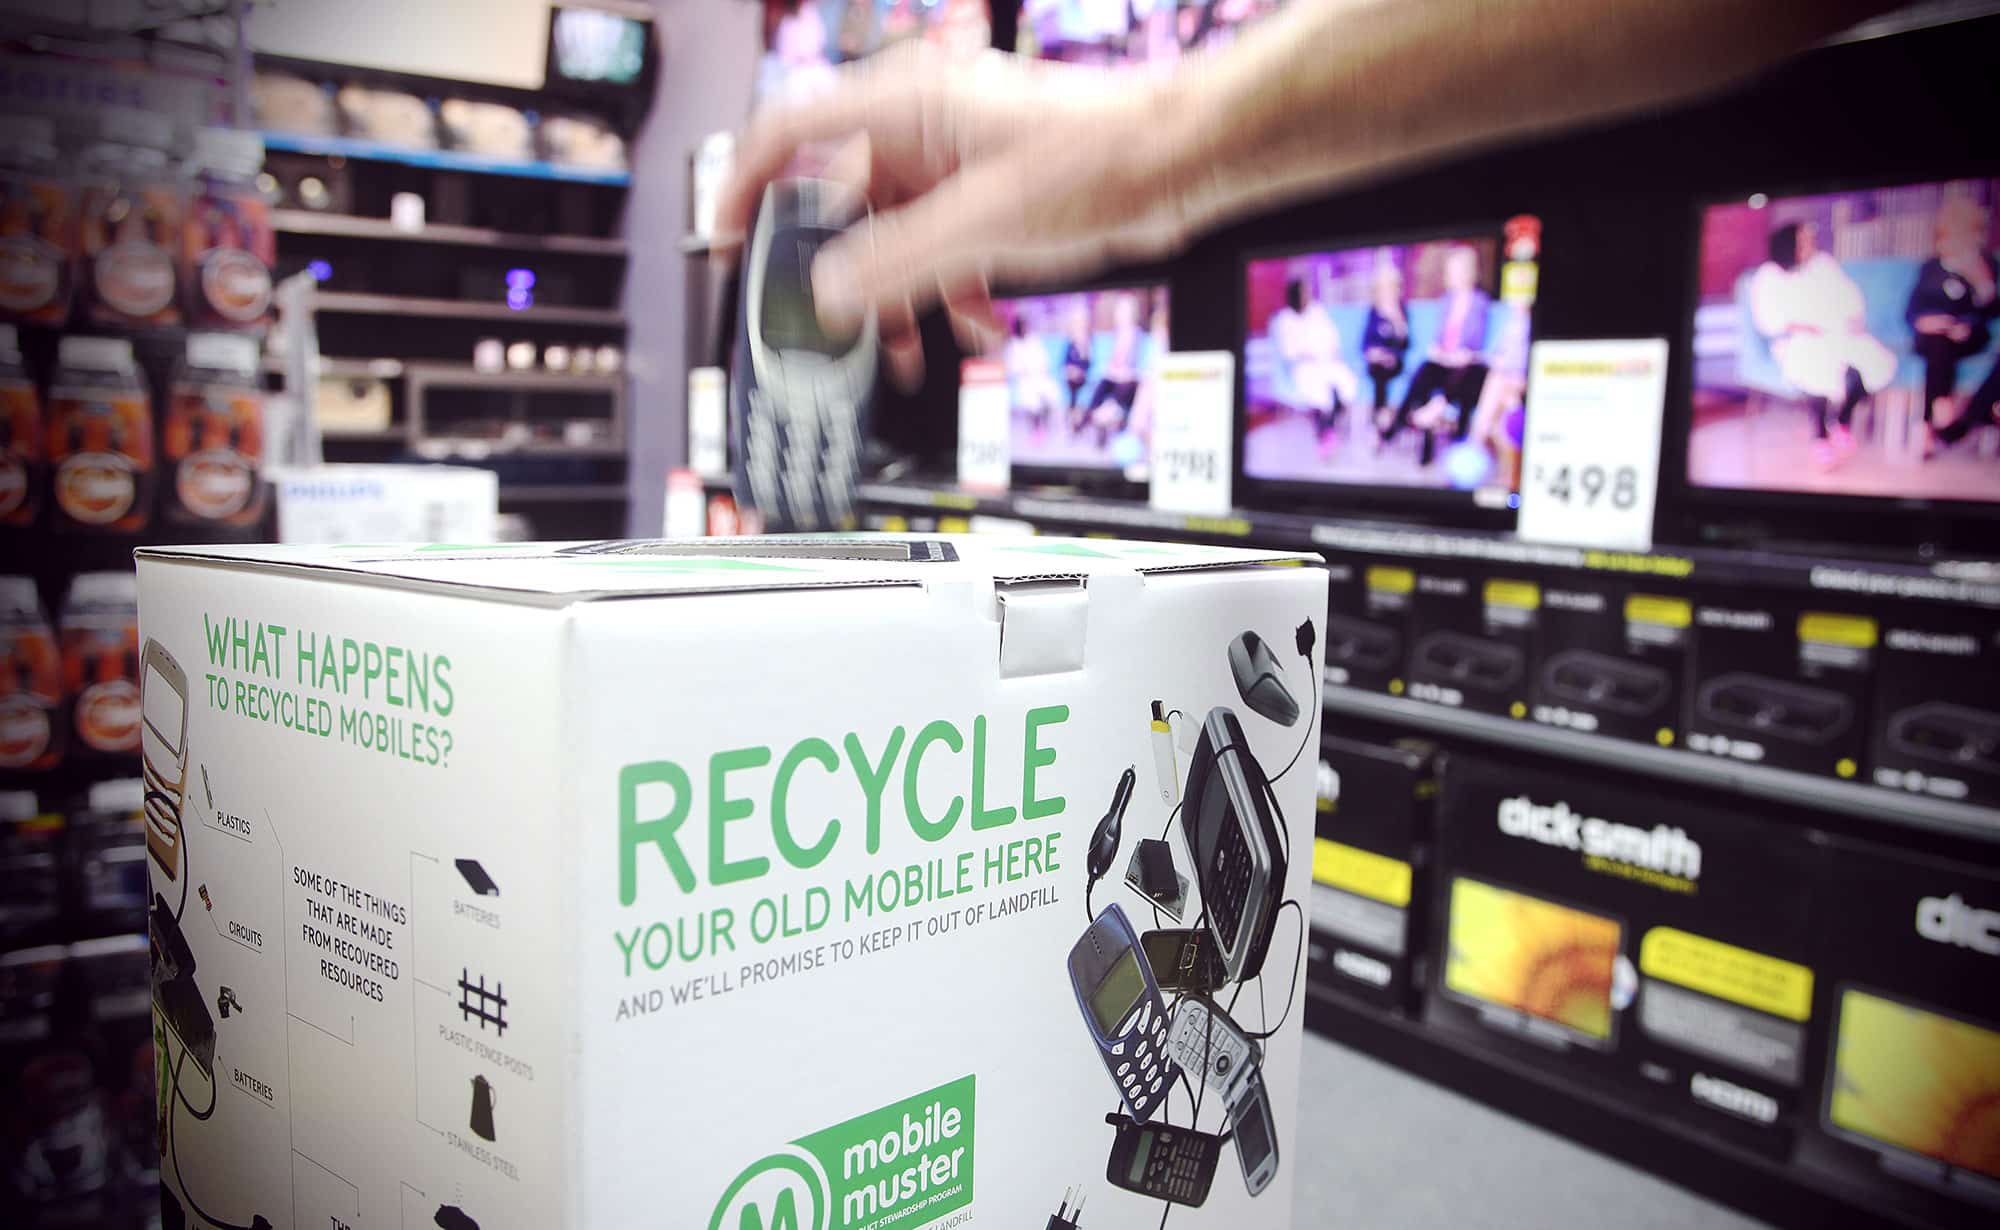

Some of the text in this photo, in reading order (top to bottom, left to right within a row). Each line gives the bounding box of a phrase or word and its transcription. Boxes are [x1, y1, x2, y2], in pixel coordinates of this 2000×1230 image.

[203, 611, 455, 718] WHAT HAPPENS
[205, 673, 453, 769] TO RECYCLED MOBILES?
[216, 810, 252, 836] PLASTICS
[619, 704, 1070, 907] RECYCLE
[293, 866, 407, 926] SOME OF THE THINGS
[306, 897, 393, 950] THAT ARE MADE
[454, 900, 502, 929] BATTERIES
[614, 831, 1062, 978] YOUR OLD MOBILE HERE
[228, 920, 263, 947] CIRCUITS
[302, 923, 399, 981] FROM RECOVERED
[615, 885, 1060, 1022] AND WE'LL PROMISE TO KEEP IT OUT OF LANDFILL
[320, 958, 384, 1003] RESOURCES
[439, 1024, 473, 1053] PLASTIC
[234, 1067, 273, 1101] BATTERIES
[844, 1101, 961, 1179] mobile
[844, 1147, 964, 1225] muster
[879, 1199, 928, 1228] STEWARDSHIP
[928, 1184, 962, 1206] PROGRAM
